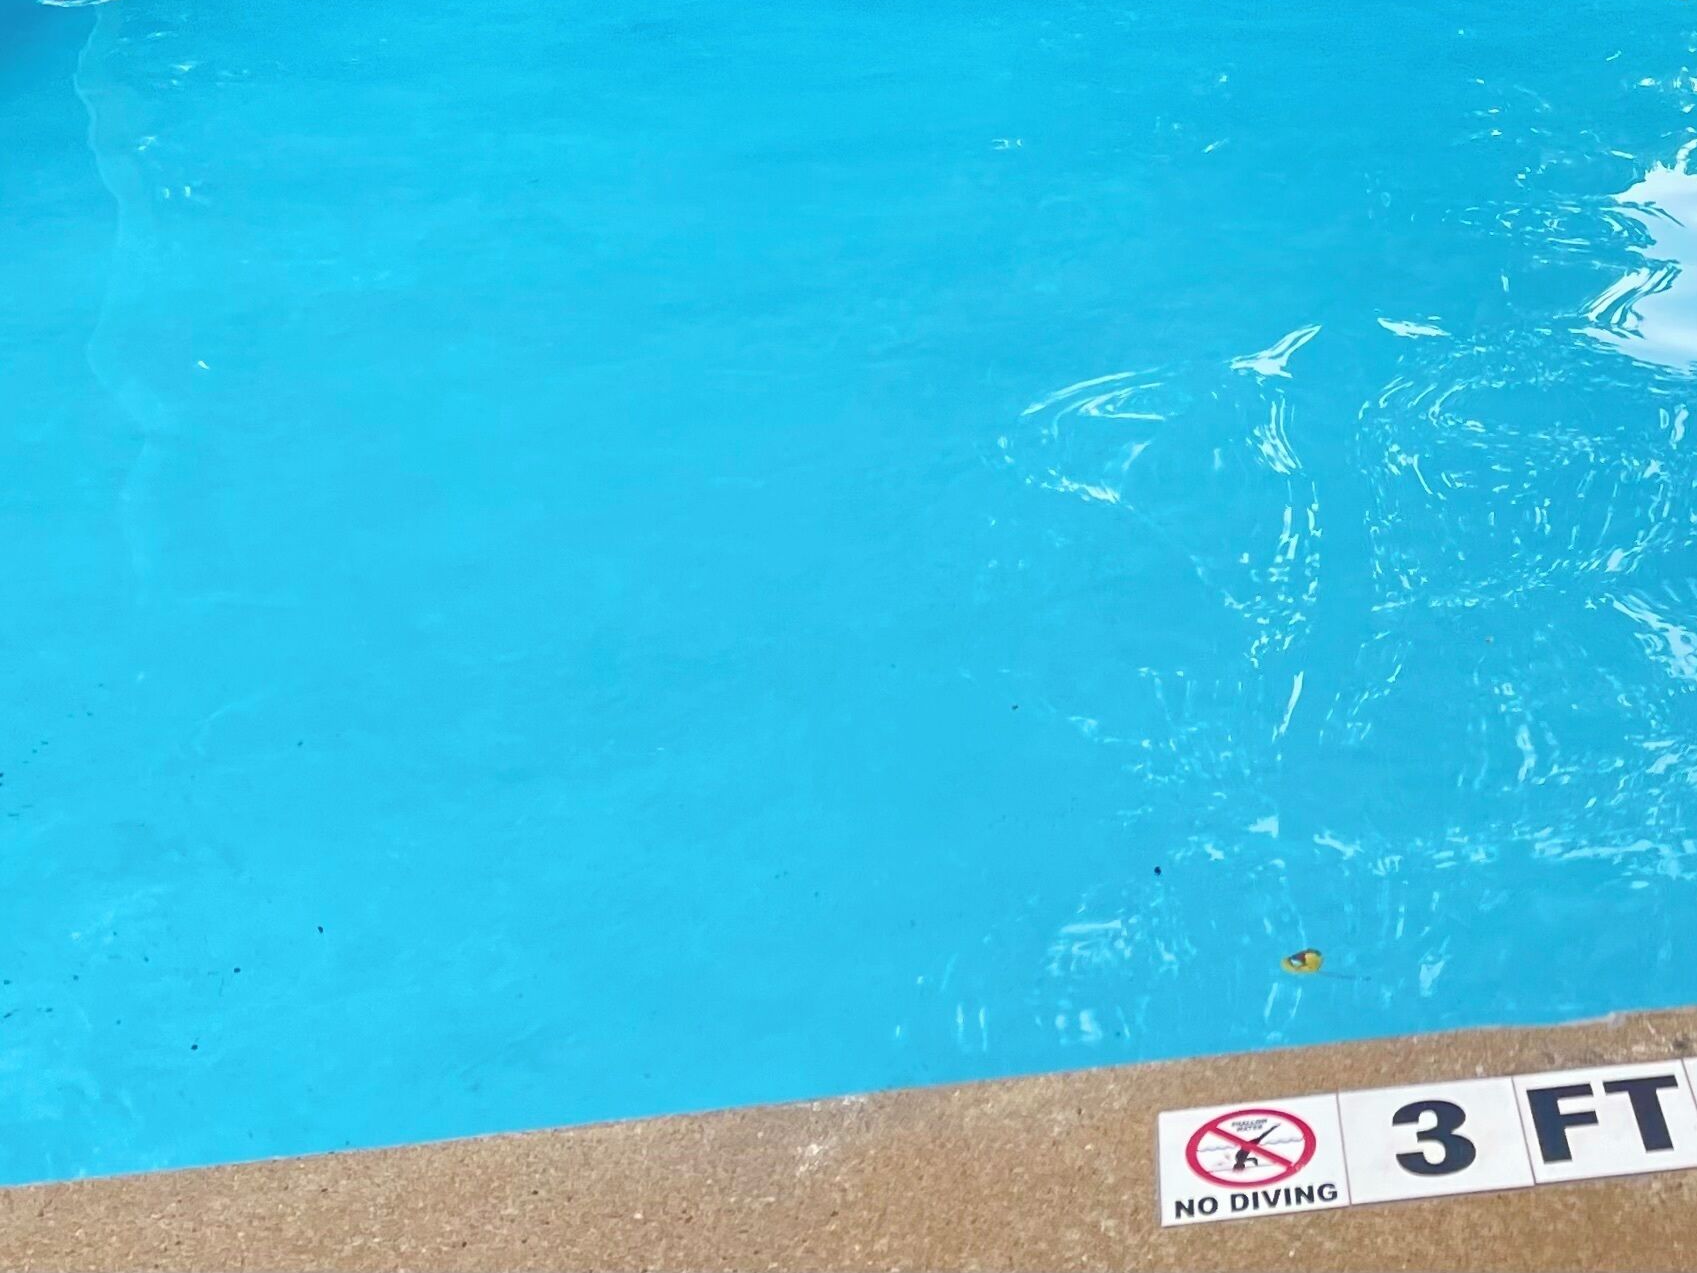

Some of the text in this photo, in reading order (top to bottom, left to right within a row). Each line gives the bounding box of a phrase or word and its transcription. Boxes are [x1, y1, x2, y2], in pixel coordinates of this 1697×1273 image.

[1391, 1099, 1476, 1175] 3
[1525, 1075, 1680, 1164] FT
[1174, 1183, 1338, 1219] NO DIVING
